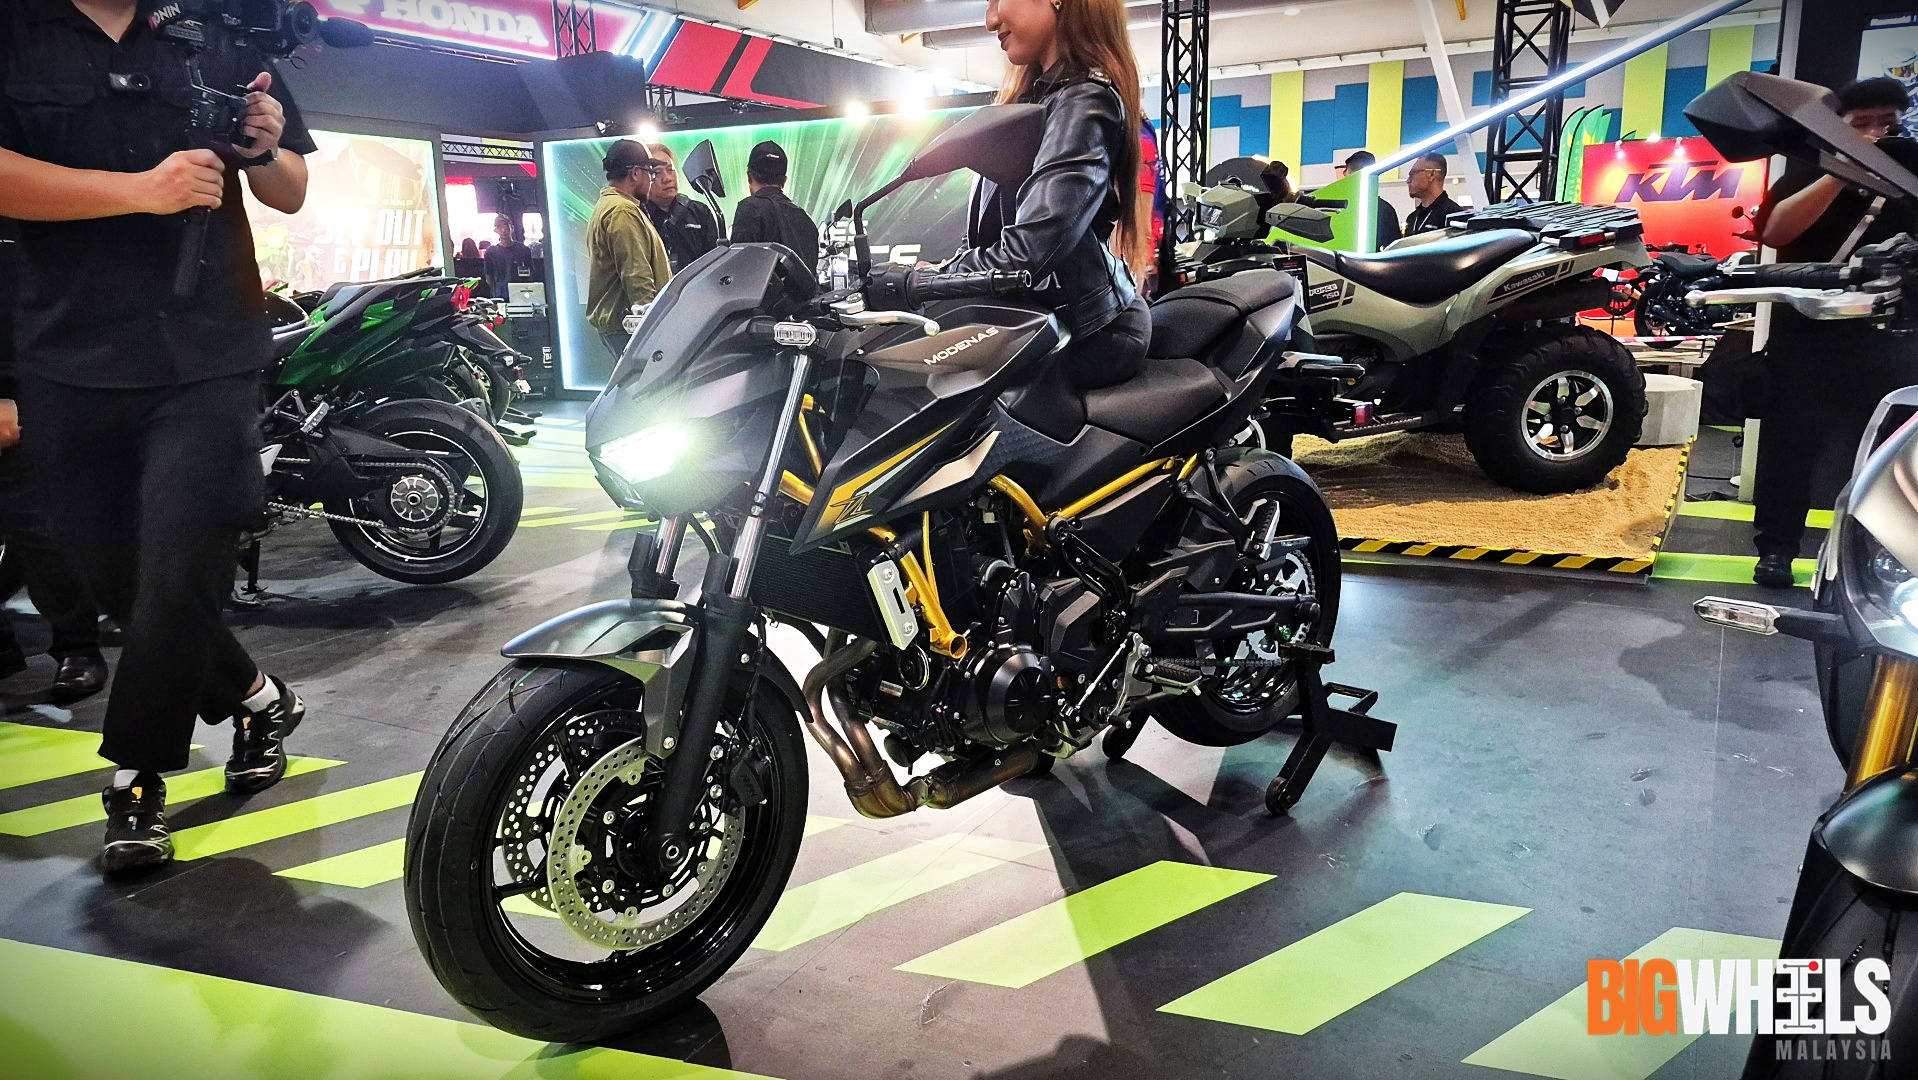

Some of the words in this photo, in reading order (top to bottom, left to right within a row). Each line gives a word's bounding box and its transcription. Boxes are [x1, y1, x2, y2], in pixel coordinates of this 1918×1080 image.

[380, 0, 549, 47] HONDA
[1614, 161, 1744, 203] KTM
[375, 209, 428, 245] OUT
[1503, 271, 1546, 292] Kawasaki
[923, 326, 999, 366] MODENAS
